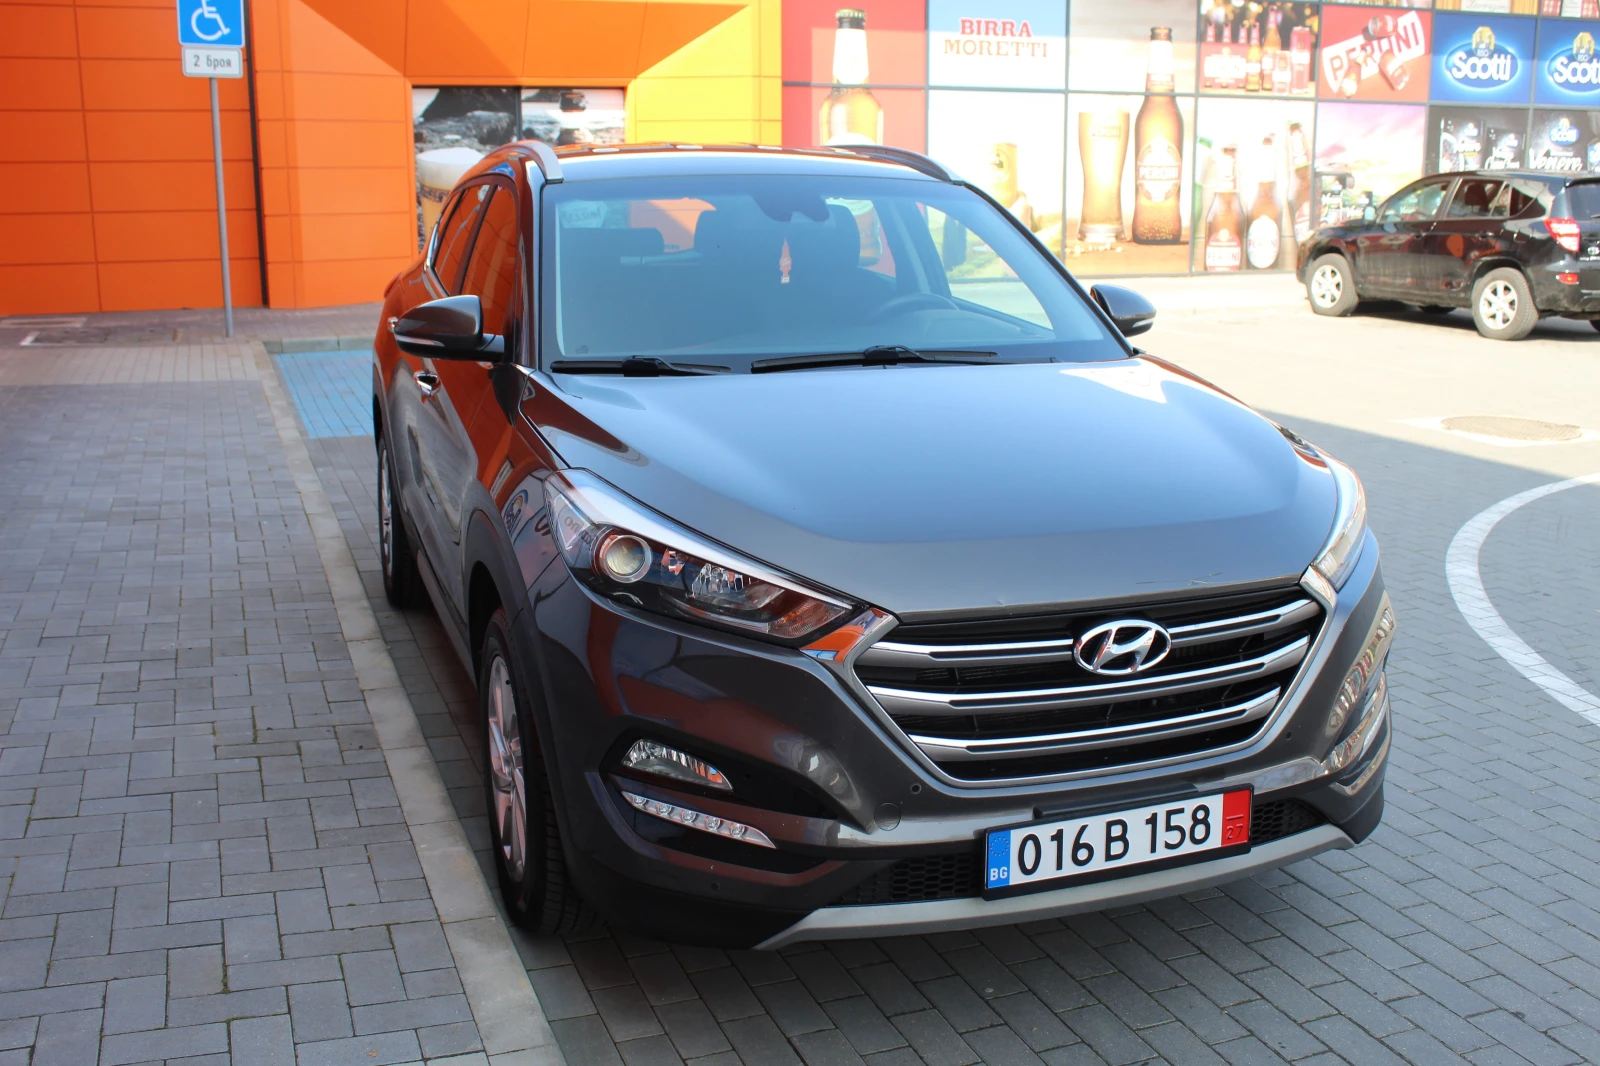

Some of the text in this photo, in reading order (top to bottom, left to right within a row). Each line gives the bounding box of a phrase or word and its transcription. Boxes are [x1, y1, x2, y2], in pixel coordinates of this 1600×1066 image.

[960, 19, 1032, 38] BIRRA
[943, 39, 1048, 58] MORETTI
[193, 54, 231, 71] 2 броя
[1451, 51, 1511, 81] Scotti
[1226, 825, 1244, 840] 27
[990, 866, 1008, 881] BG
